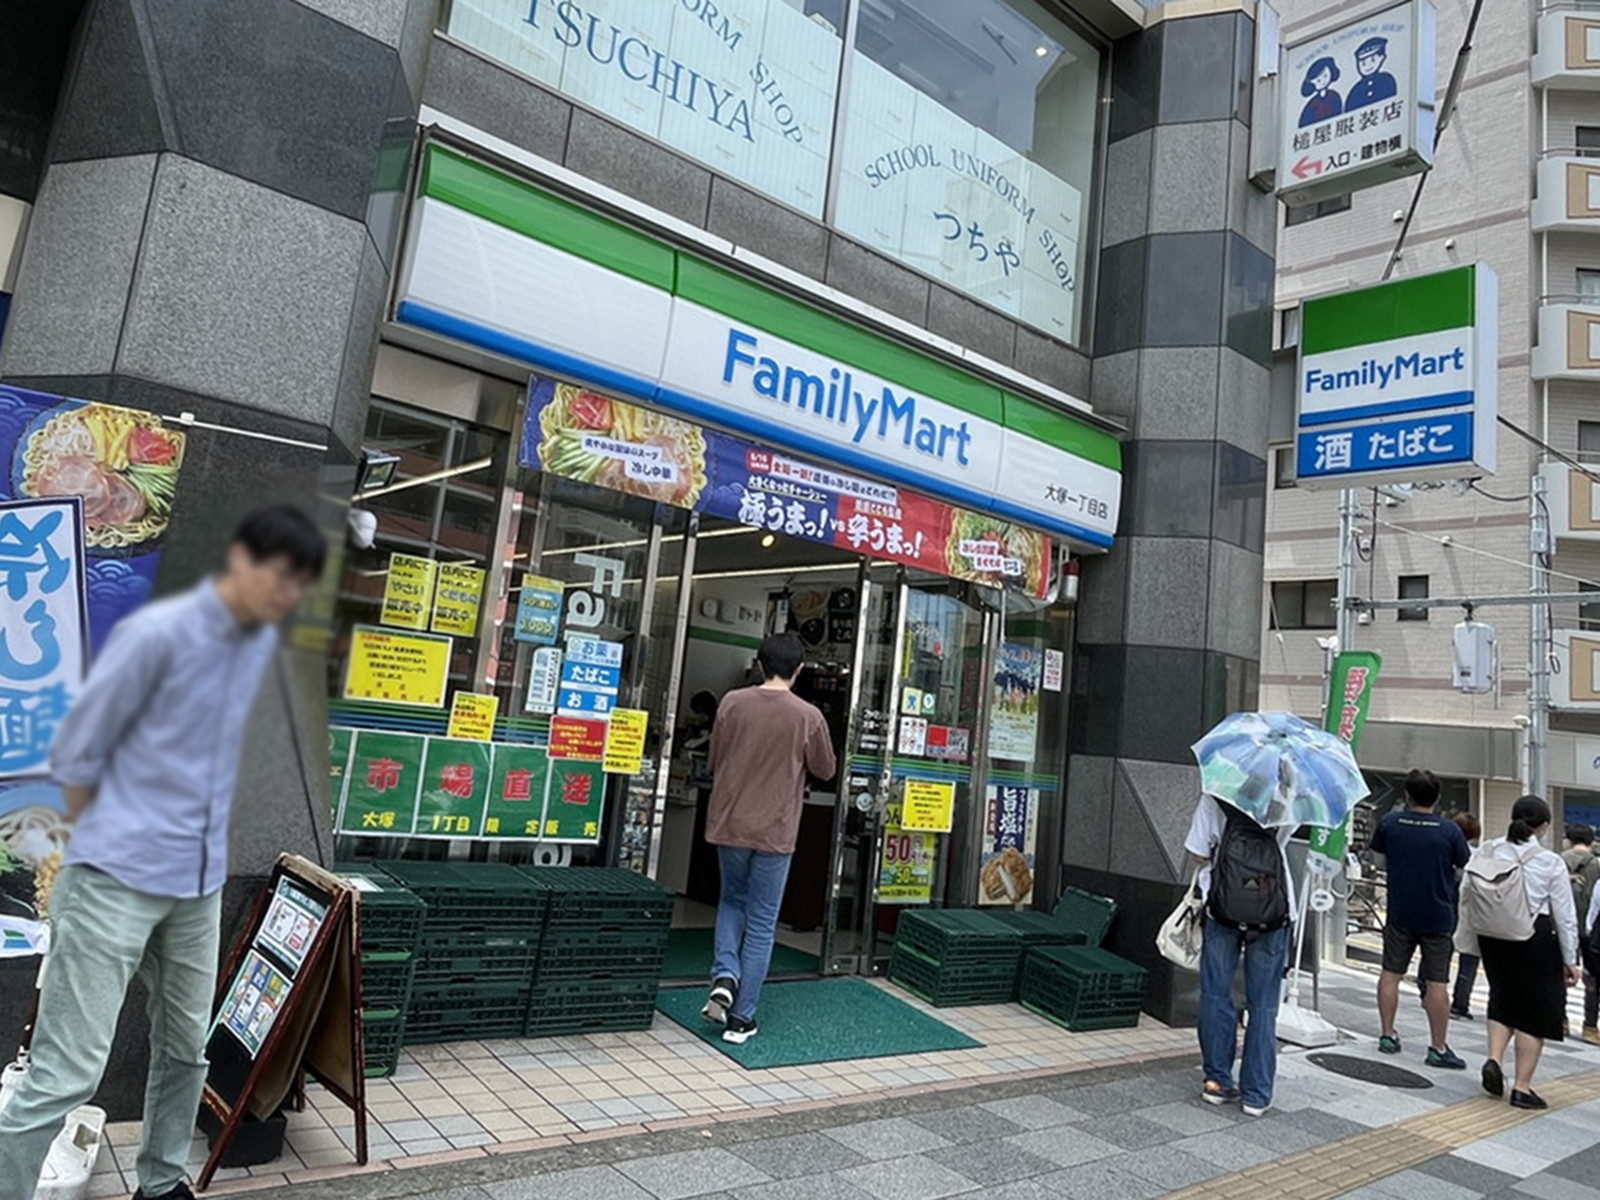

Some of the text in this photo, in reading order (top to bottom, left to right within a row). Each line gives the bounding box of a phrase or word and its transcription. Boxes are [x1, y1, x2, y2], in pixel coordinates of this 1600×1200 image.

[749, 60, 803, 144] SHOP
[1293, 100, 1404, 151] 槌屋服装店
[864, 144, 1076, 293] SCHOOL UNIFORM SHOP
[932, 211, 1020, 277] つちや
[1305, 346, 1465, 393] FamilyMart
[723, 327, 972, 468] FamilyMart
[1314, 424, 1453, 470] 酒 たばこ
[1044, 483, 1109, 520] 大塚一丁目店
[571, 665, 611, 685] たばこ
[567, 692, 609, 711] お酒
